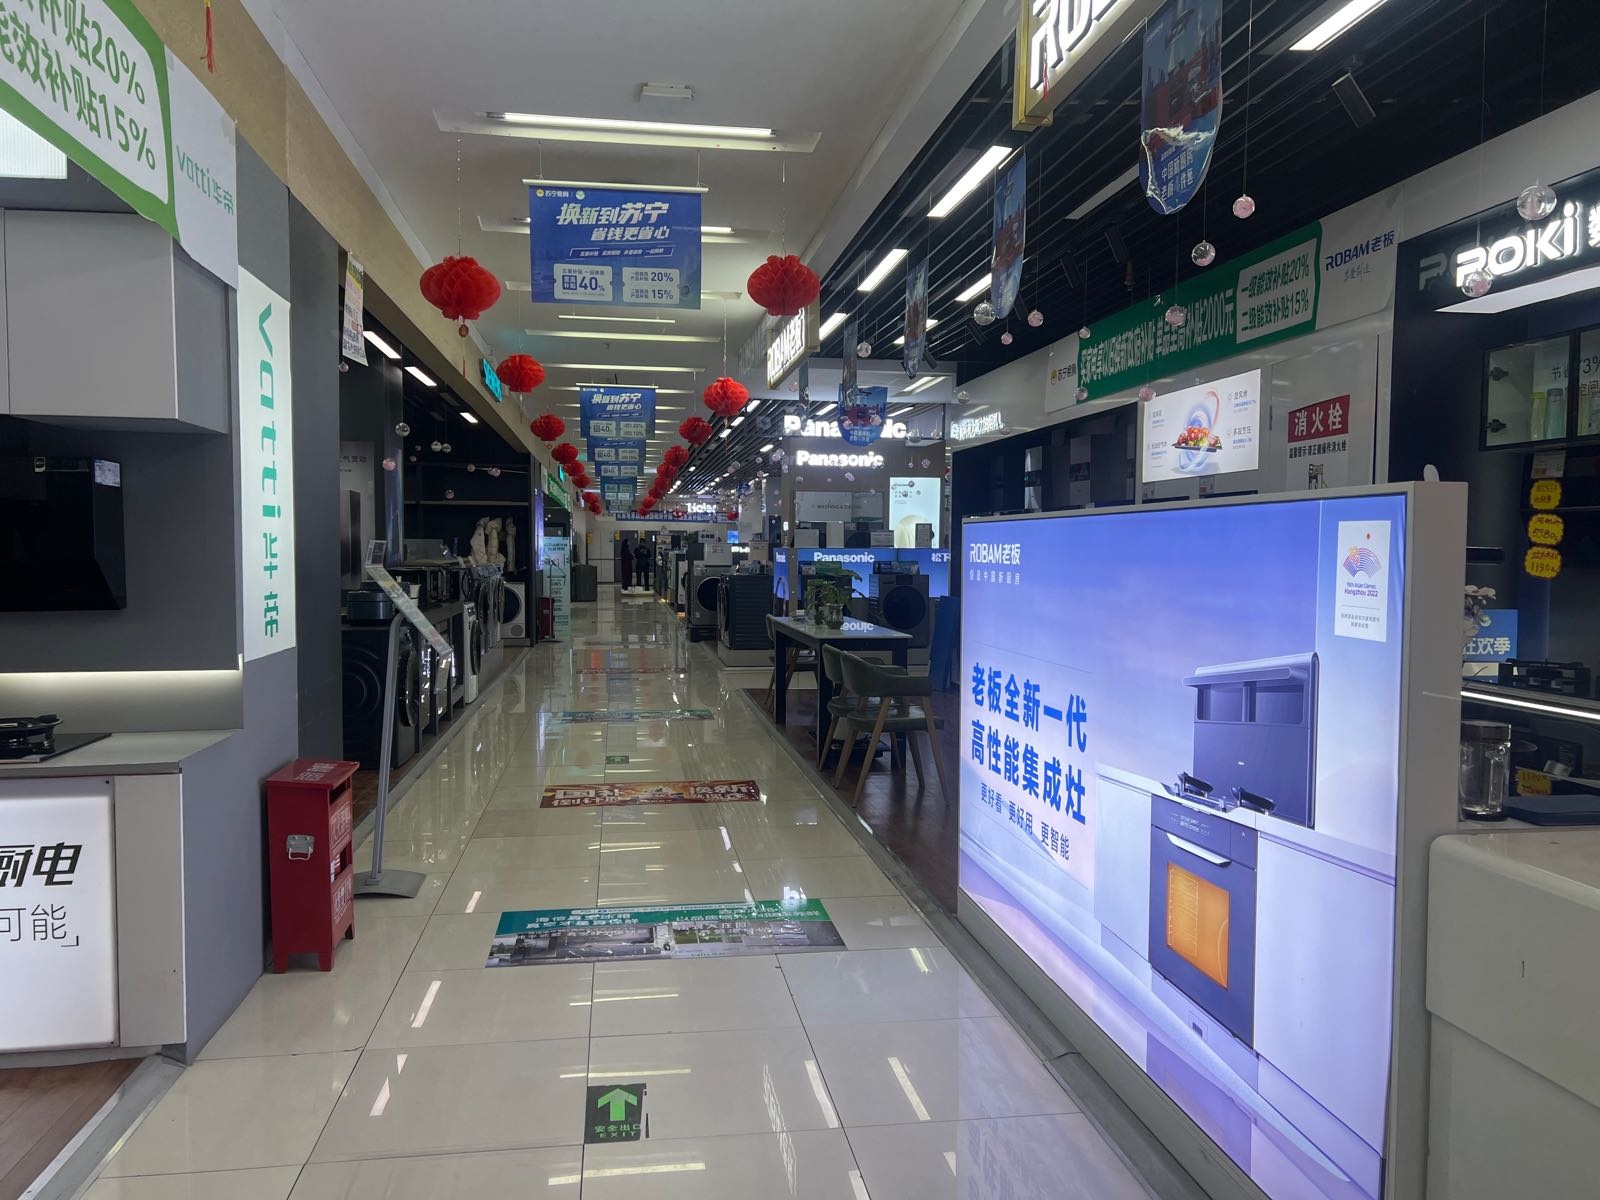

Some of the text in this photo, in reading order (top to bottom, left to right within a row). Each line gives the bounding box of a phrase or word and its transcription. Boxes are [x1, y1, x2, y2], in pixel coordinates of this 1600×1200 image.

[556, 201, 670, 225] 换新到苏宁
[591, 226, 670, 241] 省钱更省心
[1325, 229, 1396, 271] ROBAM老板
[1456, 202, 1579, 290] ROKI
[651, 272, 674, 283] 20%
[1241, 253, 1310, 300] 一级能效补贴20%
[652, 289, 674, 300] 15%
[1241, 290, 1310, 332] 二级能效补贴15%
[784, 415, 907, 438] Panaic
[1294, 402, 1344, 437] 消火栓
[797, 450, 884, 467] Panasonic
[814, 551, 875, 563] Panasonic
[969, 543, 1021, 566] ROBAM老板
[1343, 587, 1379, 597] Hangzhou 2022
[971, 662, 1087, 752] 老板全新一代
[971, 719, 1087, 826] 高性能集成灶
[980, 781, 1070, 861] 更好看 更好用 更智能
[594, 1124, 641, 1133] 安全出口
